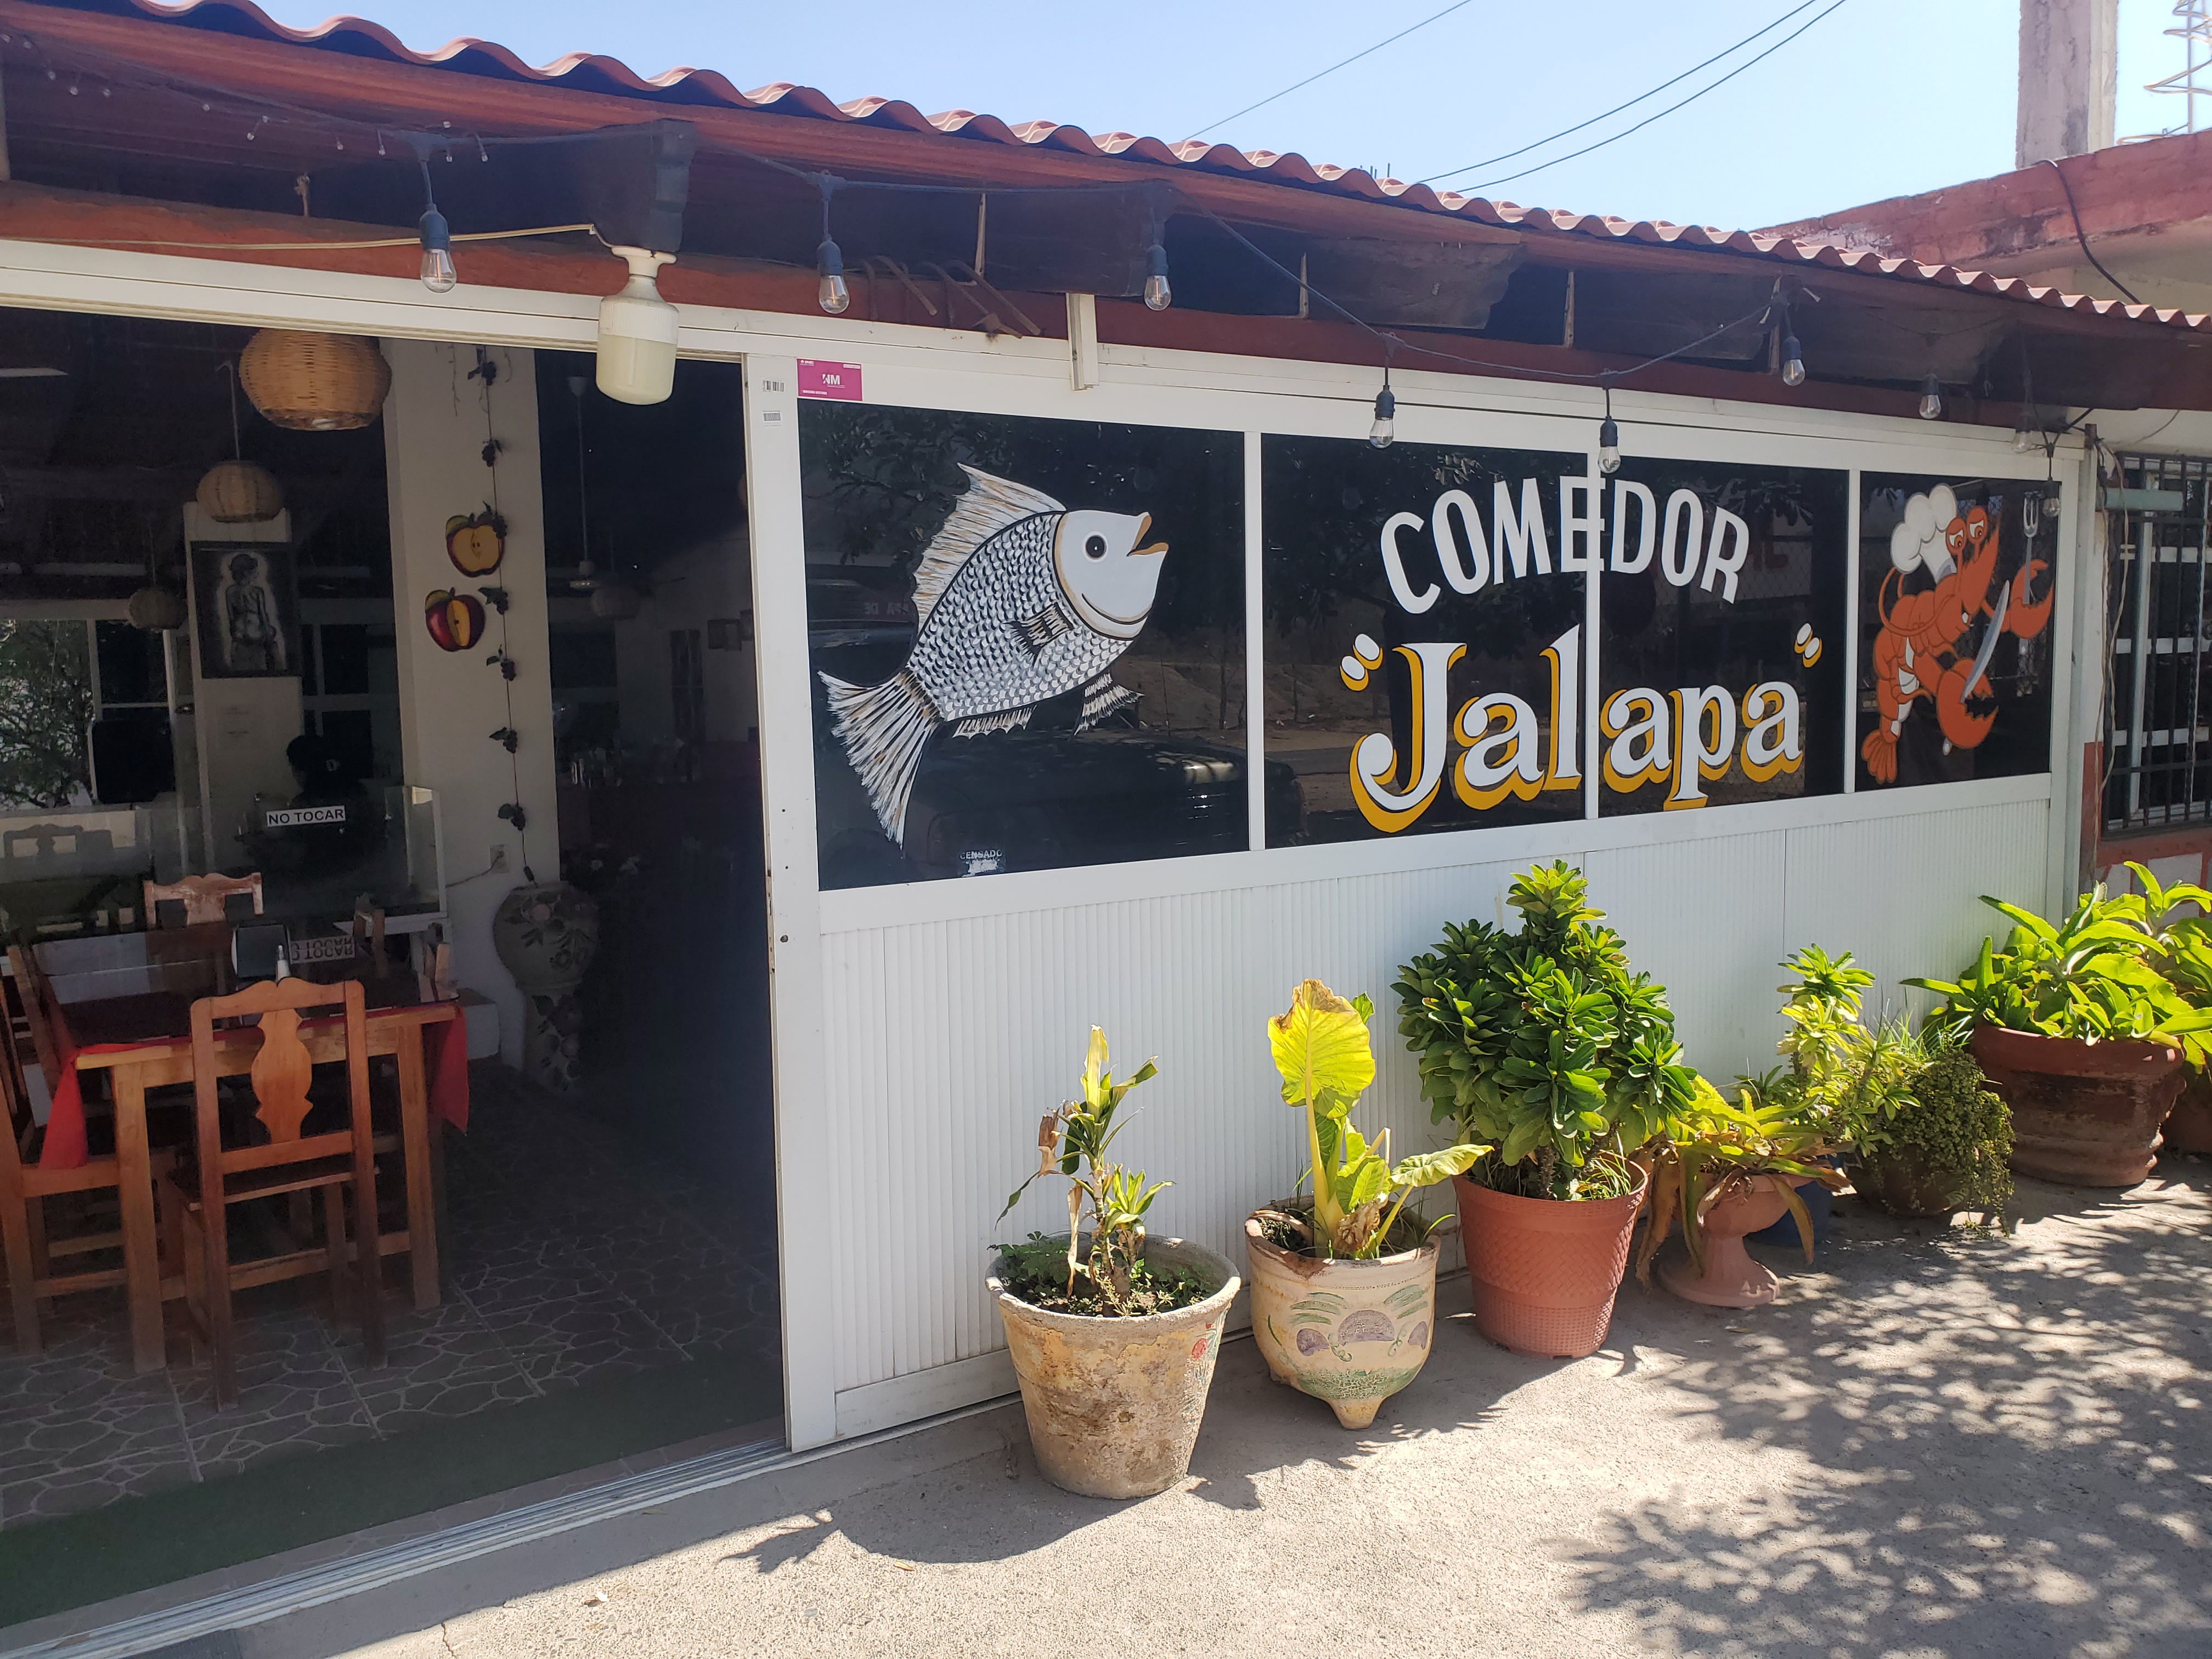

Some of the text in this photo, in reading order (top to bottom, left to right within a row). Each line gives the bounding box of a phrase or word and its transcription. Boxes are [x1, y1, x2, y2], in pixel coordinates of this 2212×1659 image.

[1380, 475, 1750, 614] COMEDOR
[269, 809, 343, 825] NO TOCAR
